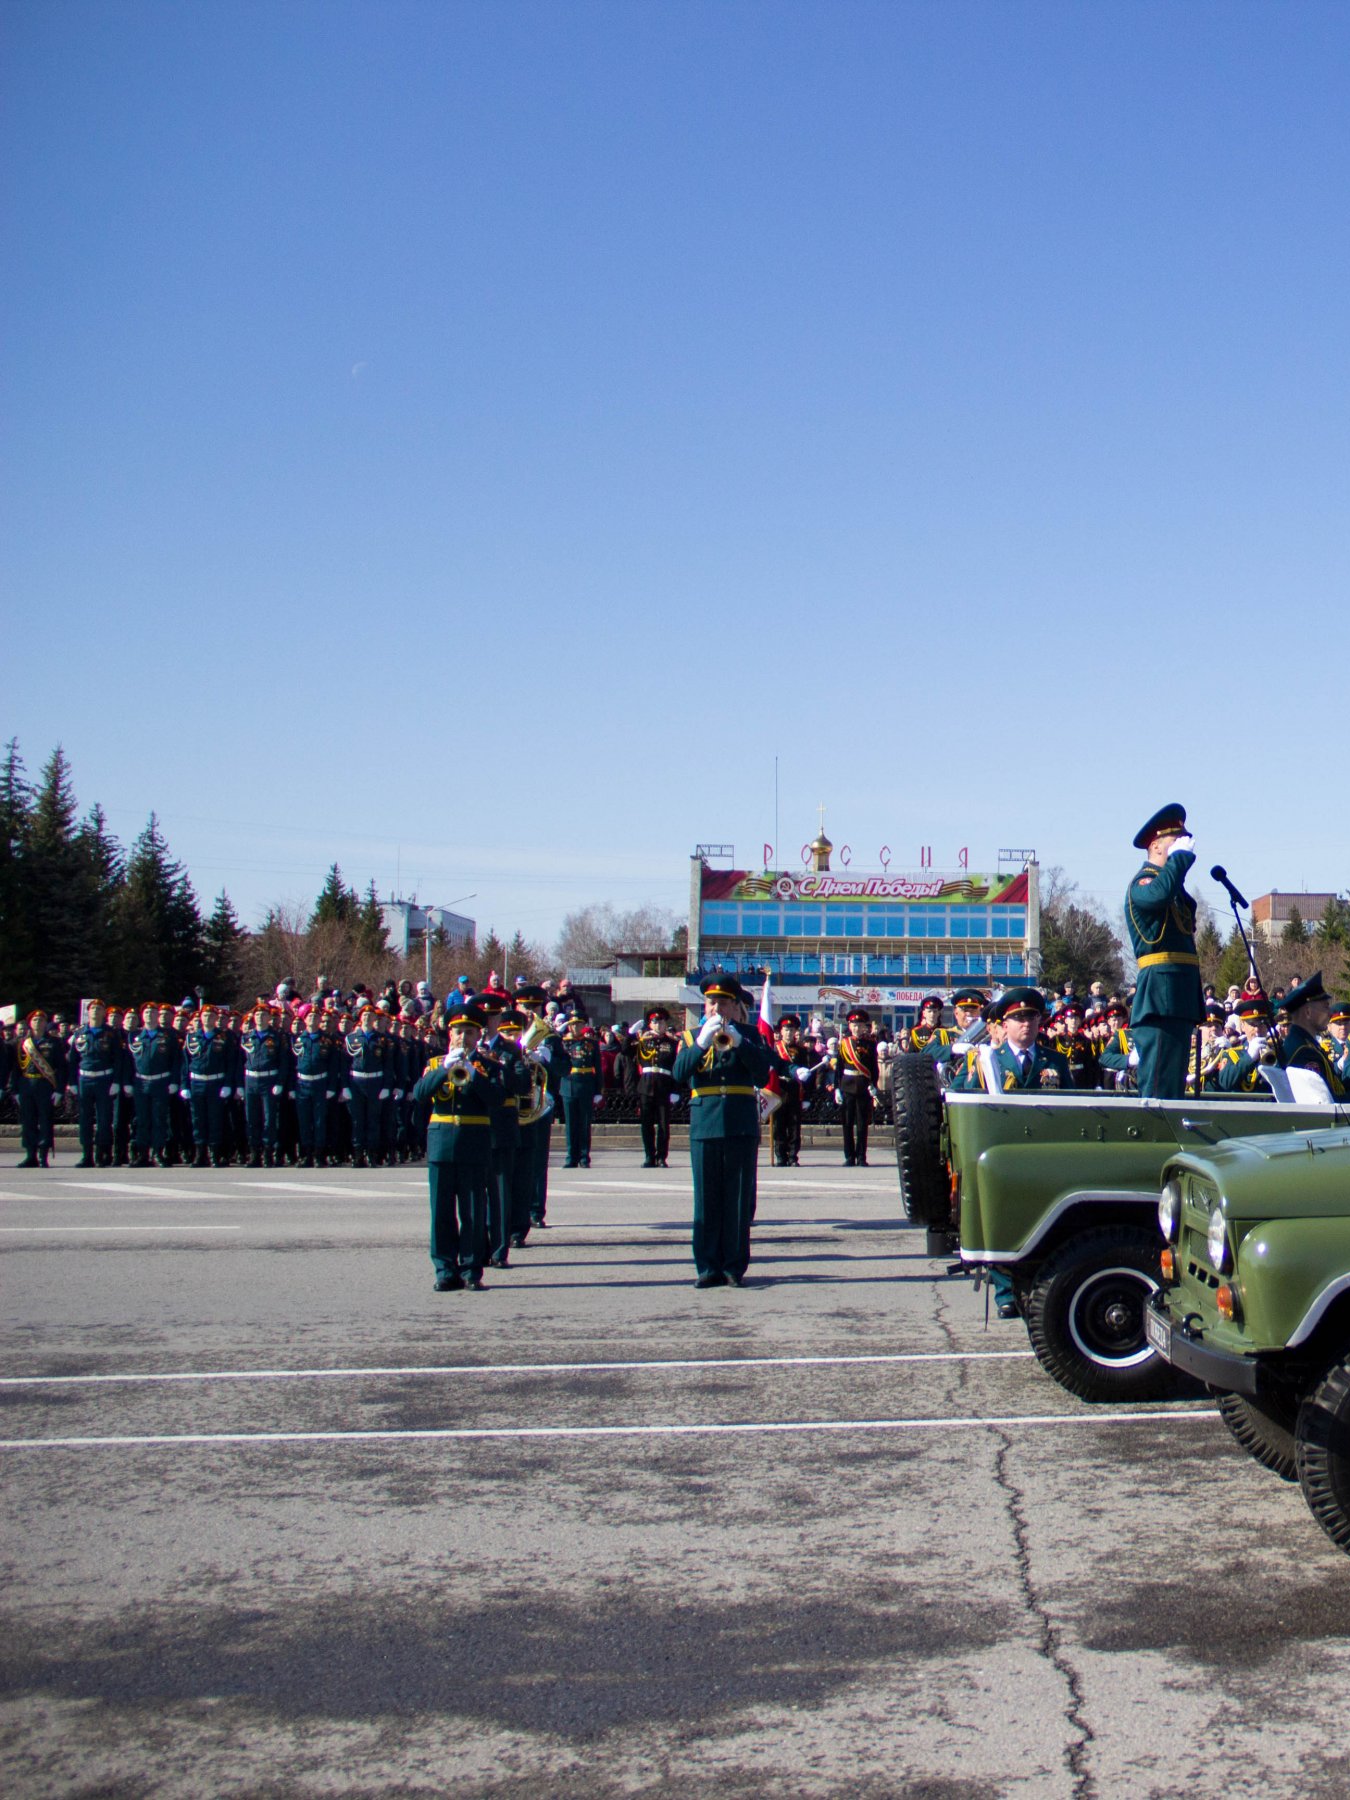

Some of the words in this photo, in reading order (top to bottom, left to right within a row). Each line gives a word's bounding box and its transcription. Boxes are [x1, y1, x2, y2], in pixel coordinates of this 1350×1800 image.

[764, 843, 968, 868] РОССИЯ
[800, 877, 815, 895] С
[813, 878, 863, 898] Днем
[865, 878, 944, 898] Победы!
